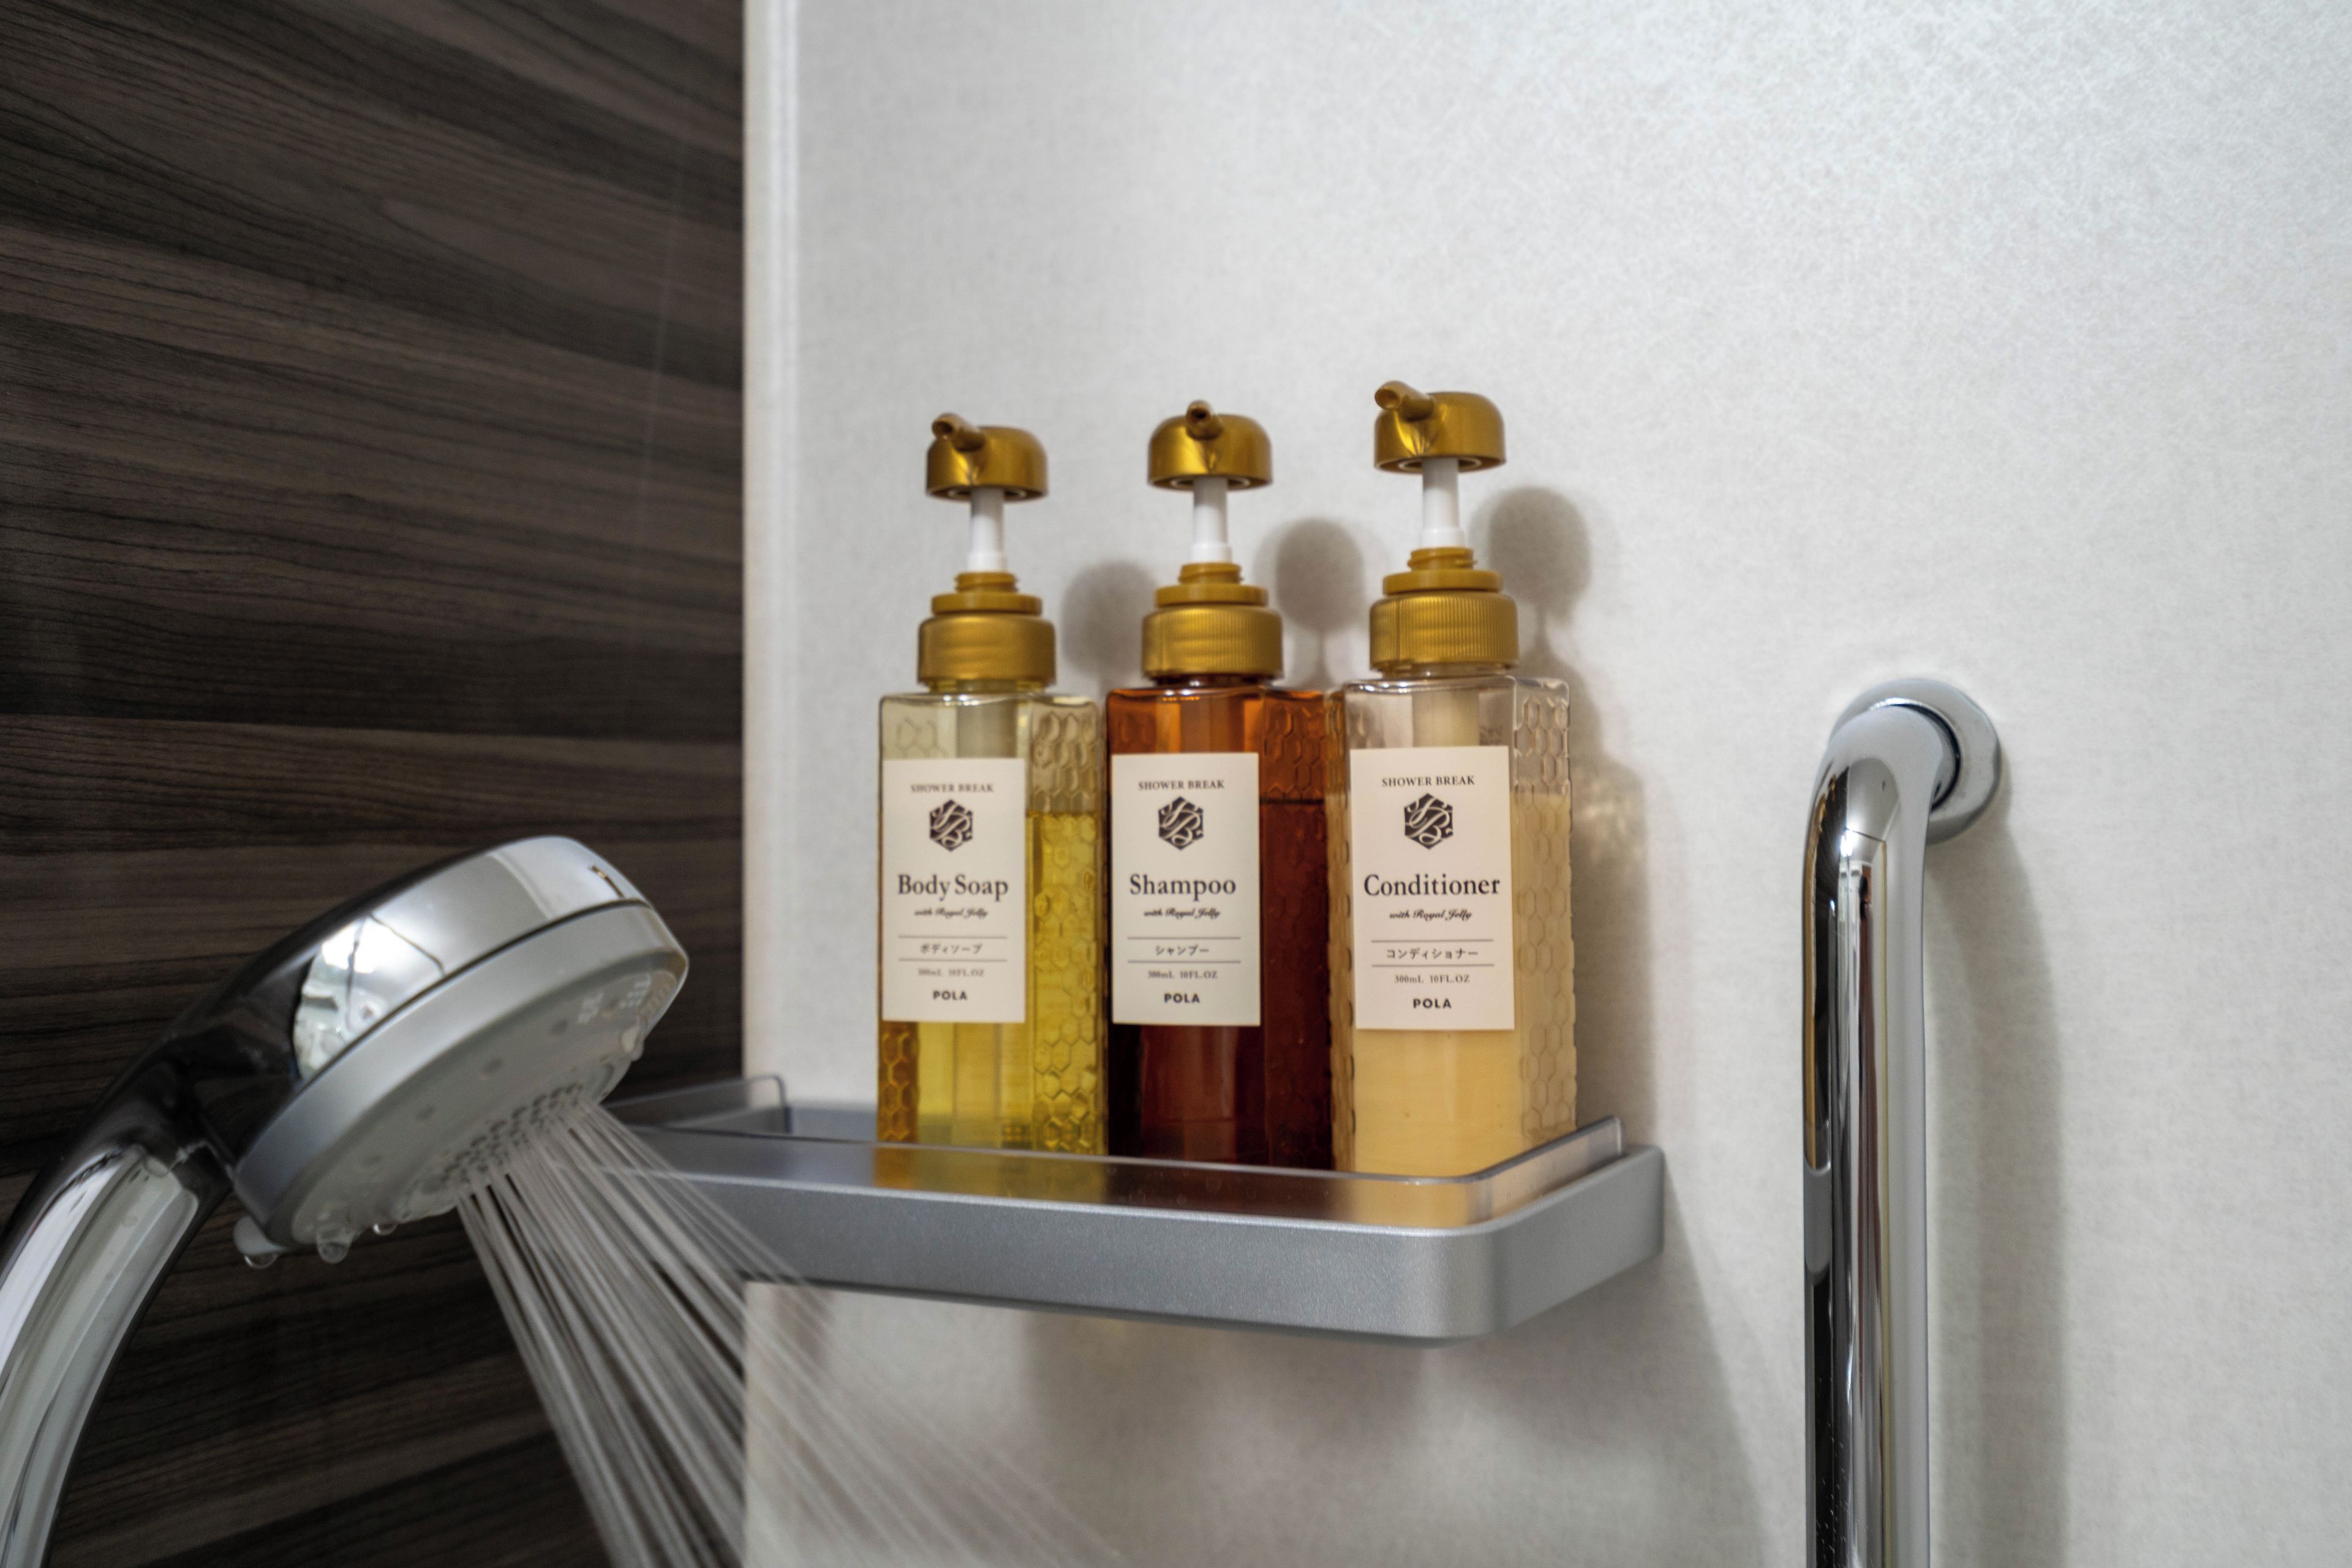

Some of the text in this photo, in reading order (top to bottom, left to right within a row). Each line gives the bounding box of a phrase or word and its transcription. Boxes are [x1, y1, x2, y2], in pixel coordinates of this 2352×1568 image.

[1138, 778, 1224, 791] SHOWER BREAK
[1382, 775, 1475, 787] SHOWER BREAK
[910, 783, 993, 793] SHOWER BREAK
[897, 873, 1009, 902] Body Soap
[1129, 873, 1237, 902] Shampoo
[1363, 873, 1501, 897] Conditioner
[935, 907, 964, 919] Royal
[963, 908, 989, 919] Jelly
[1144, 907, 1221, 919] with Royal Jelly
[1389, 909, 1472, 922] with Royal Jelly
[920, 943, 983, 954] ボディソープ
[1155, 944, 1210, 956] シャンプー
[1387, 948, 1479, 960] コンディショナー
[1395, 974, 1425, 984] 300mL
[932, 990, 968, 1001] POLA
[1163, 992, 1200, 1004] POLA
[1412, 998, 1452, 1009] POLA
